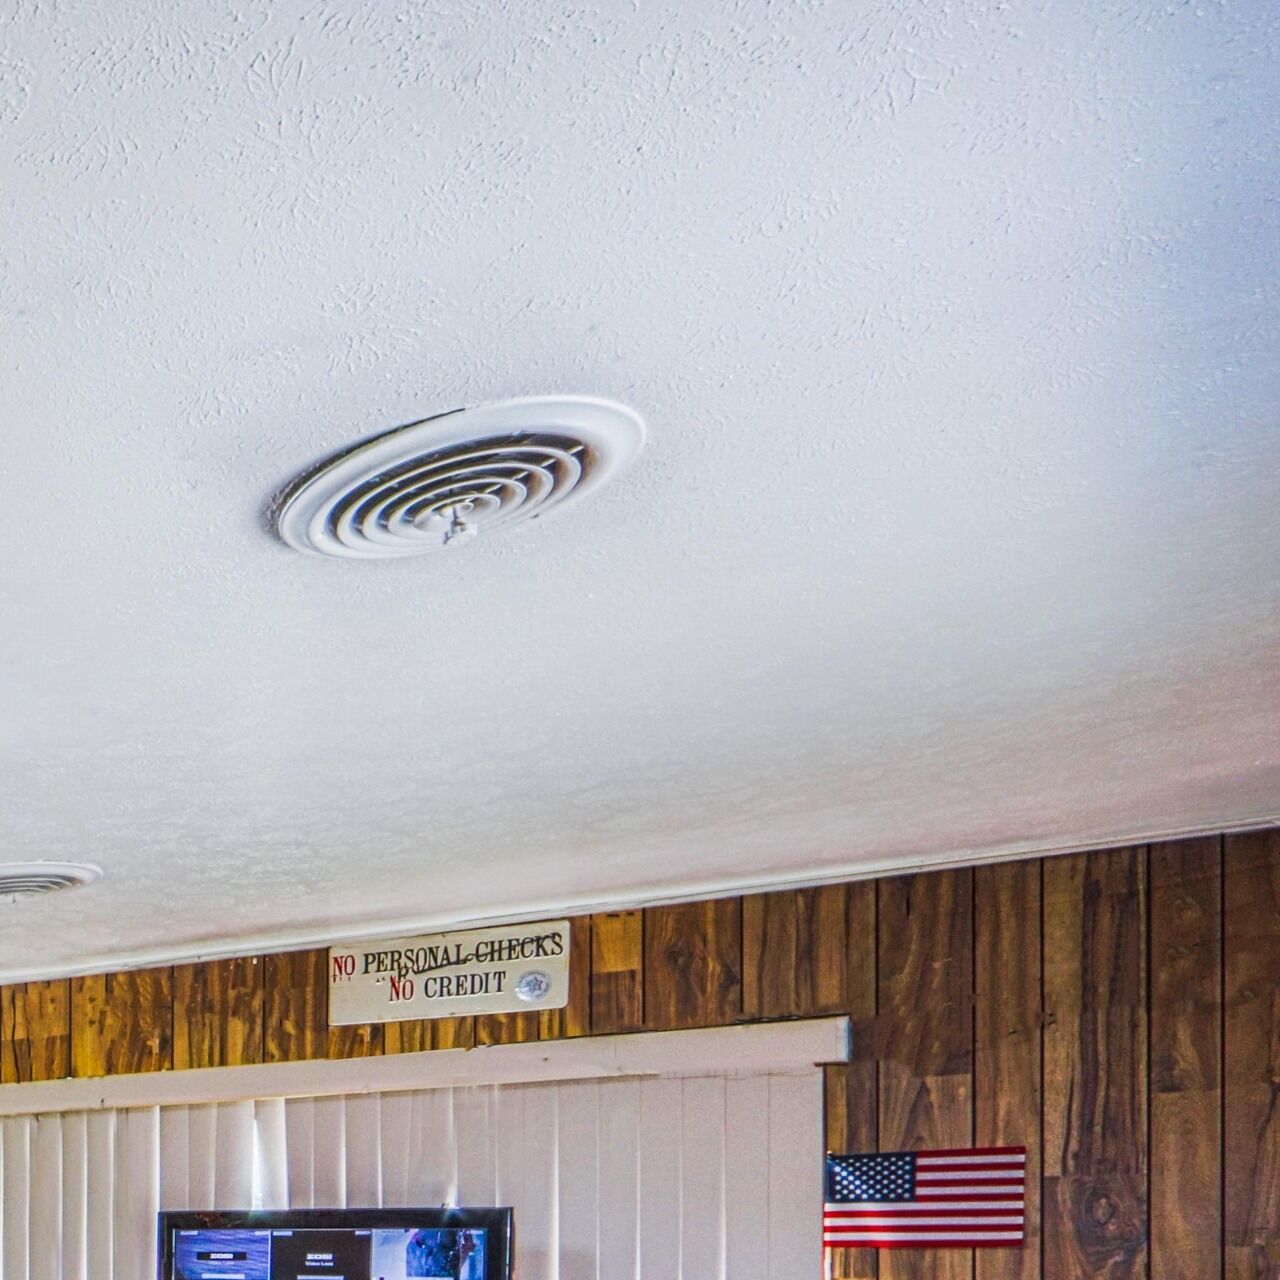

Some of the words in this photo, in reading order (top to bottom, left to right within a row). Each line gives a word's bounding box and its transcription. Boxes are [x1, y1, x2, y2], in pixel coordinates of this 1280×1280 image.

[332, 954, 356, 976] NO
[362, 943, 466, 975] PERSONAL
[475, 932, 564, 961] CHECKS
[389, 976, 415, 1002] NO
[424, 971, 507, 999] CREDIT
